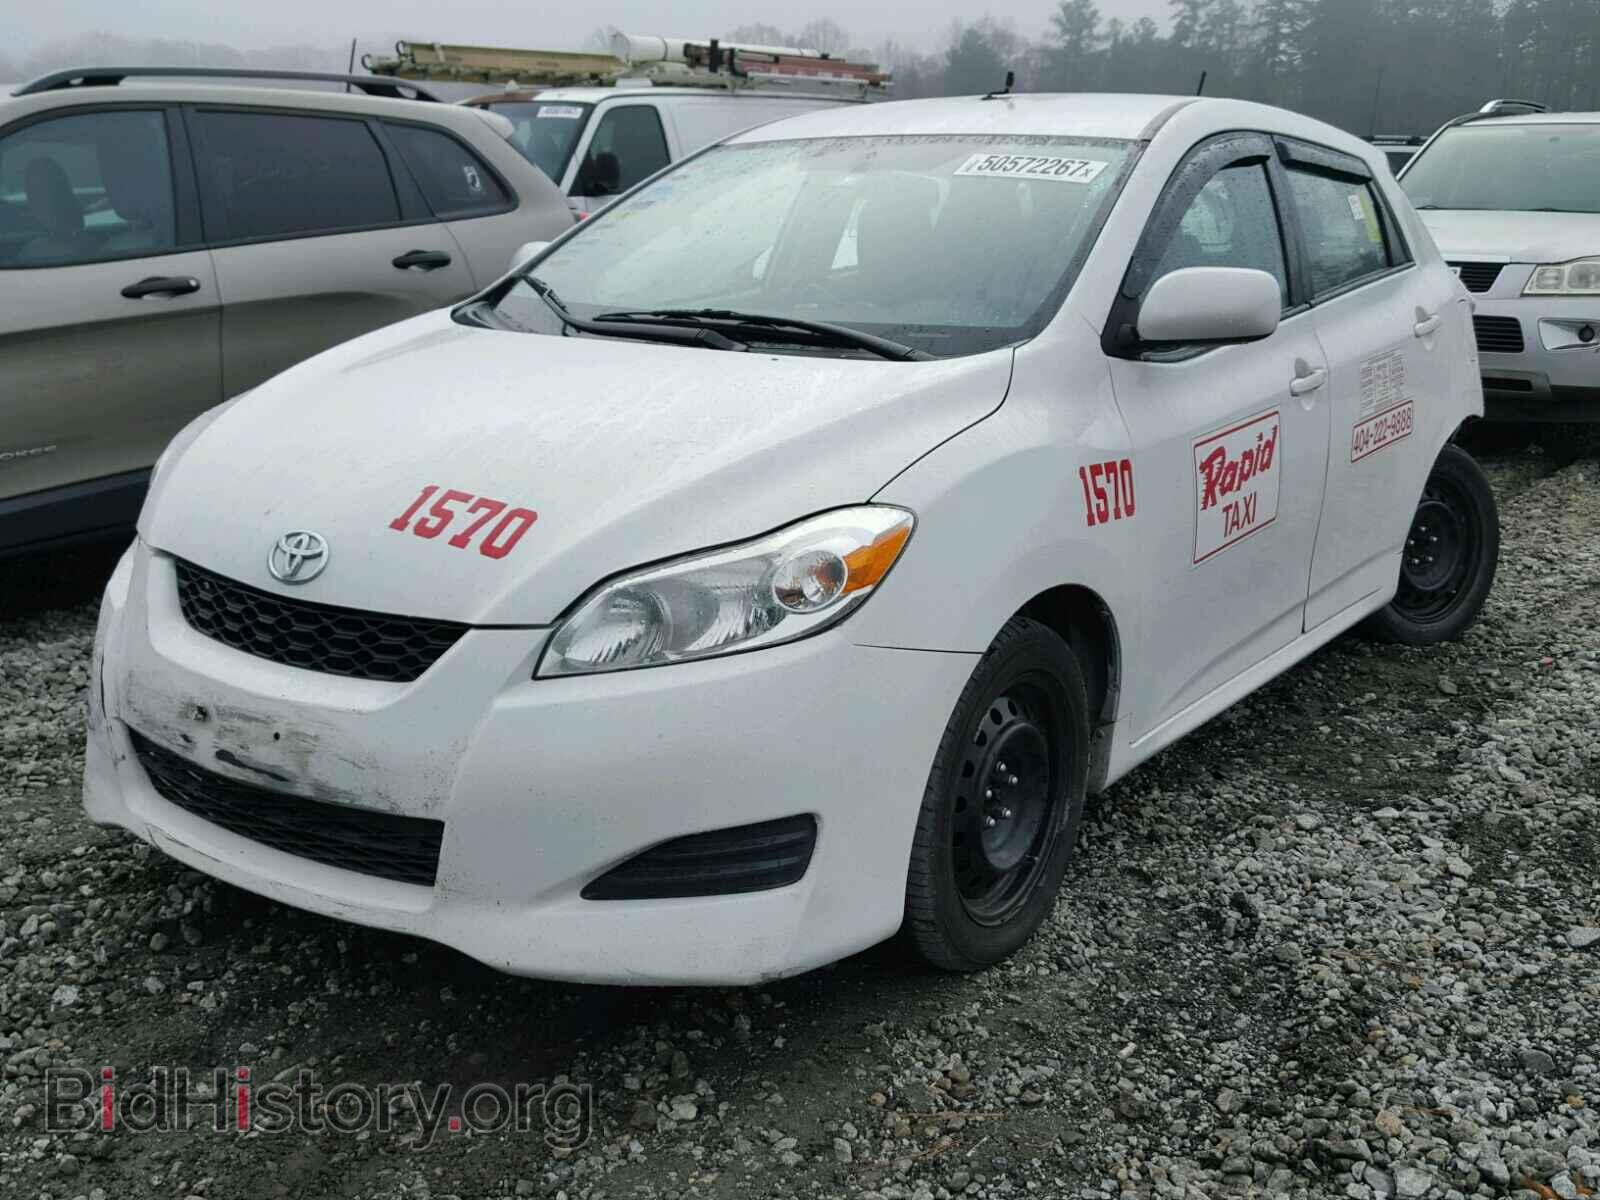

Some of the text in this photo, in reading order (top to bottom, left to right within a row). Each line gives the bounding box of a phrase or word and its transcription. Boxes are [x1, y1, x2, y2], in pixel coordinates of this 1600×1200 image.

[1079, 459, 1135, 526] 1570
[1199, 425, 1278, 511] Rapid
[389, 485, 538, 559] 1570
[1222, 491, 1257, 538] TAXI
